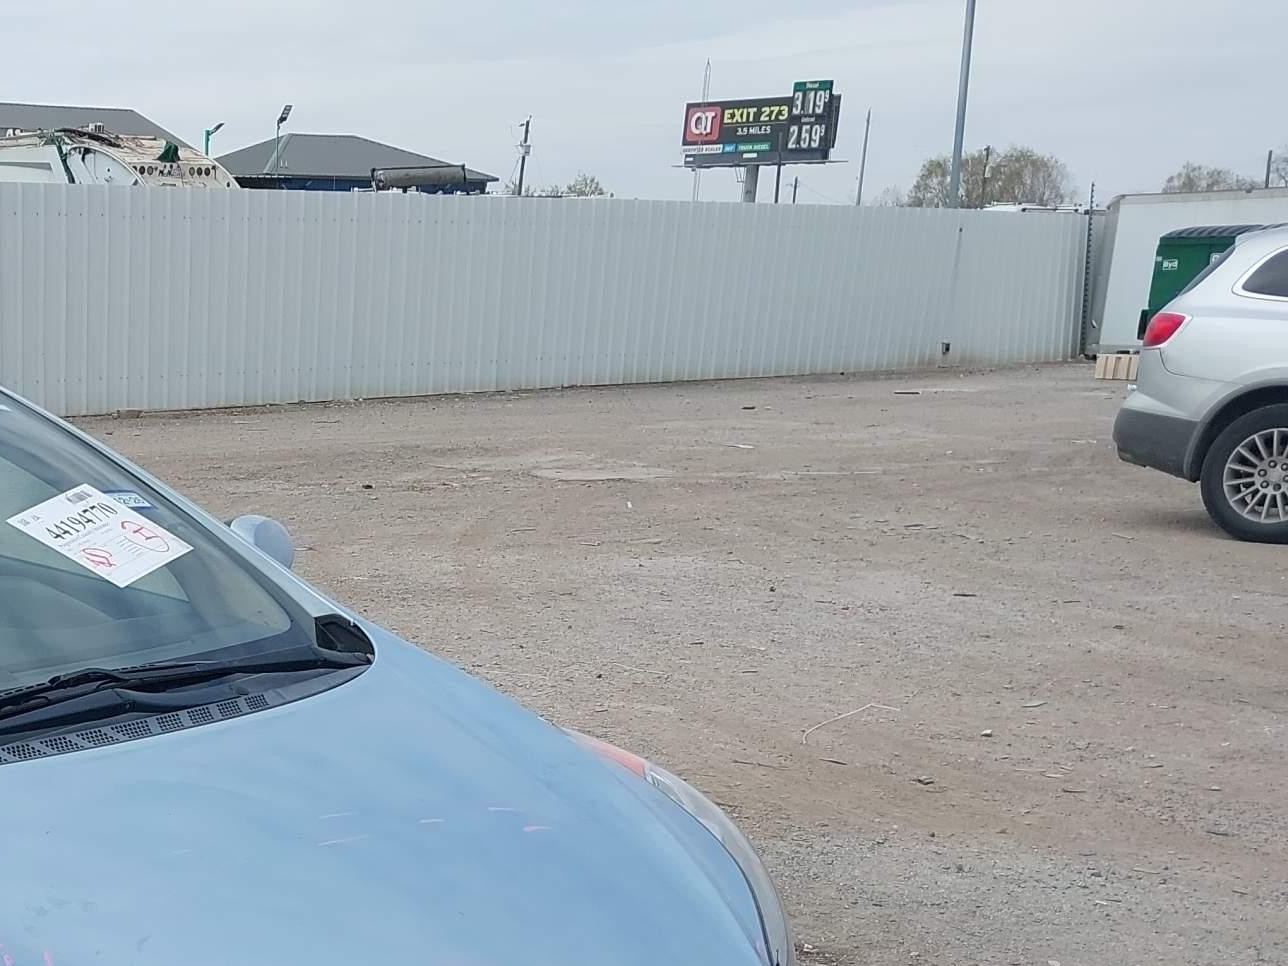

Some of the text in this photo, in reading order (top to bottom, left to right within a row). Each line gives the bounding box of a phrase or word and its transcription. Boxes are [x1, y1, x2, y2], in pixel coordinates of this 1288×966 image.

[690, 111, 716, 135] QT
[723, 105, 789, 124] EXIT 273
[748, 126, 772, 135] MILES
[45, 502, 118, 540] 44194770
